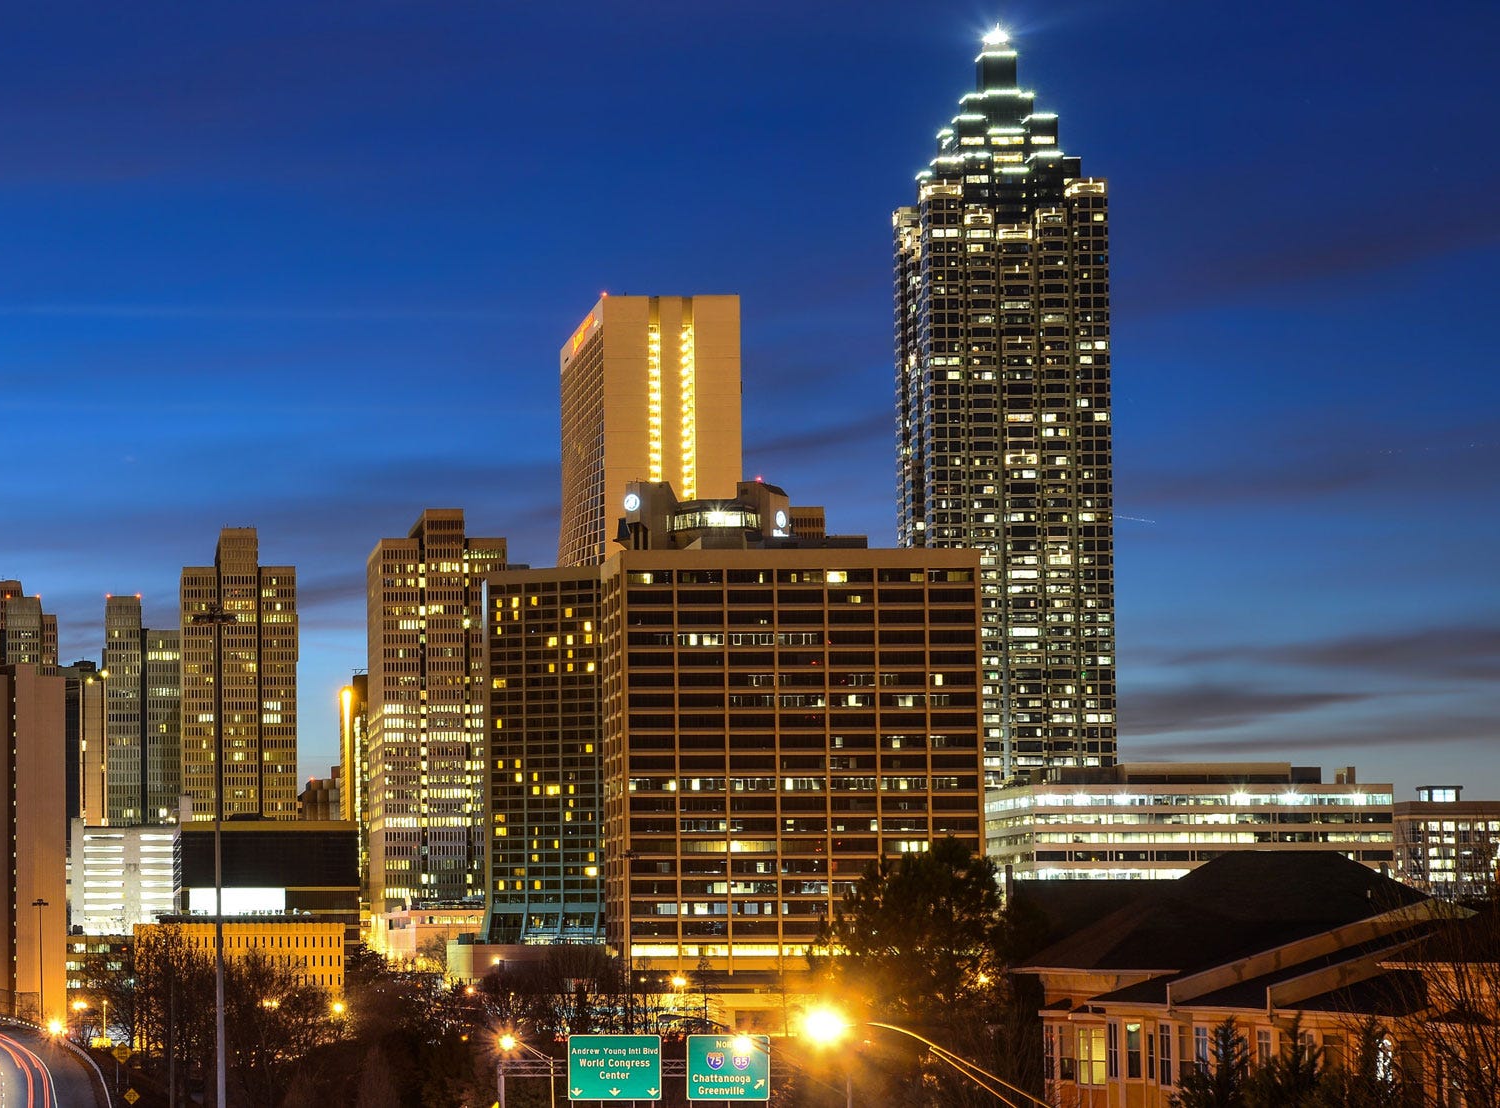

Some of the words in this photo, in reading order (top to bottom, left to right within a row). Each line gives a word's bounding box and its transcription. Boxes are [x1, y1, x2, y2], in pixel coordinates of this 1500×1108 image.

[603, 1048, 626, 1056] Young
[580, 1058, 604, 1067] World
[608, 1058, 650, 1069] Congress
[710, 1056, 722, 1066] 75
[735, 1056, 748, 1066] 85
[599, 1071, 630, 1080] Center
[692, 1073, 751, 1085] Chattanooga
[698, 1086, 745, 1095] Greenville
